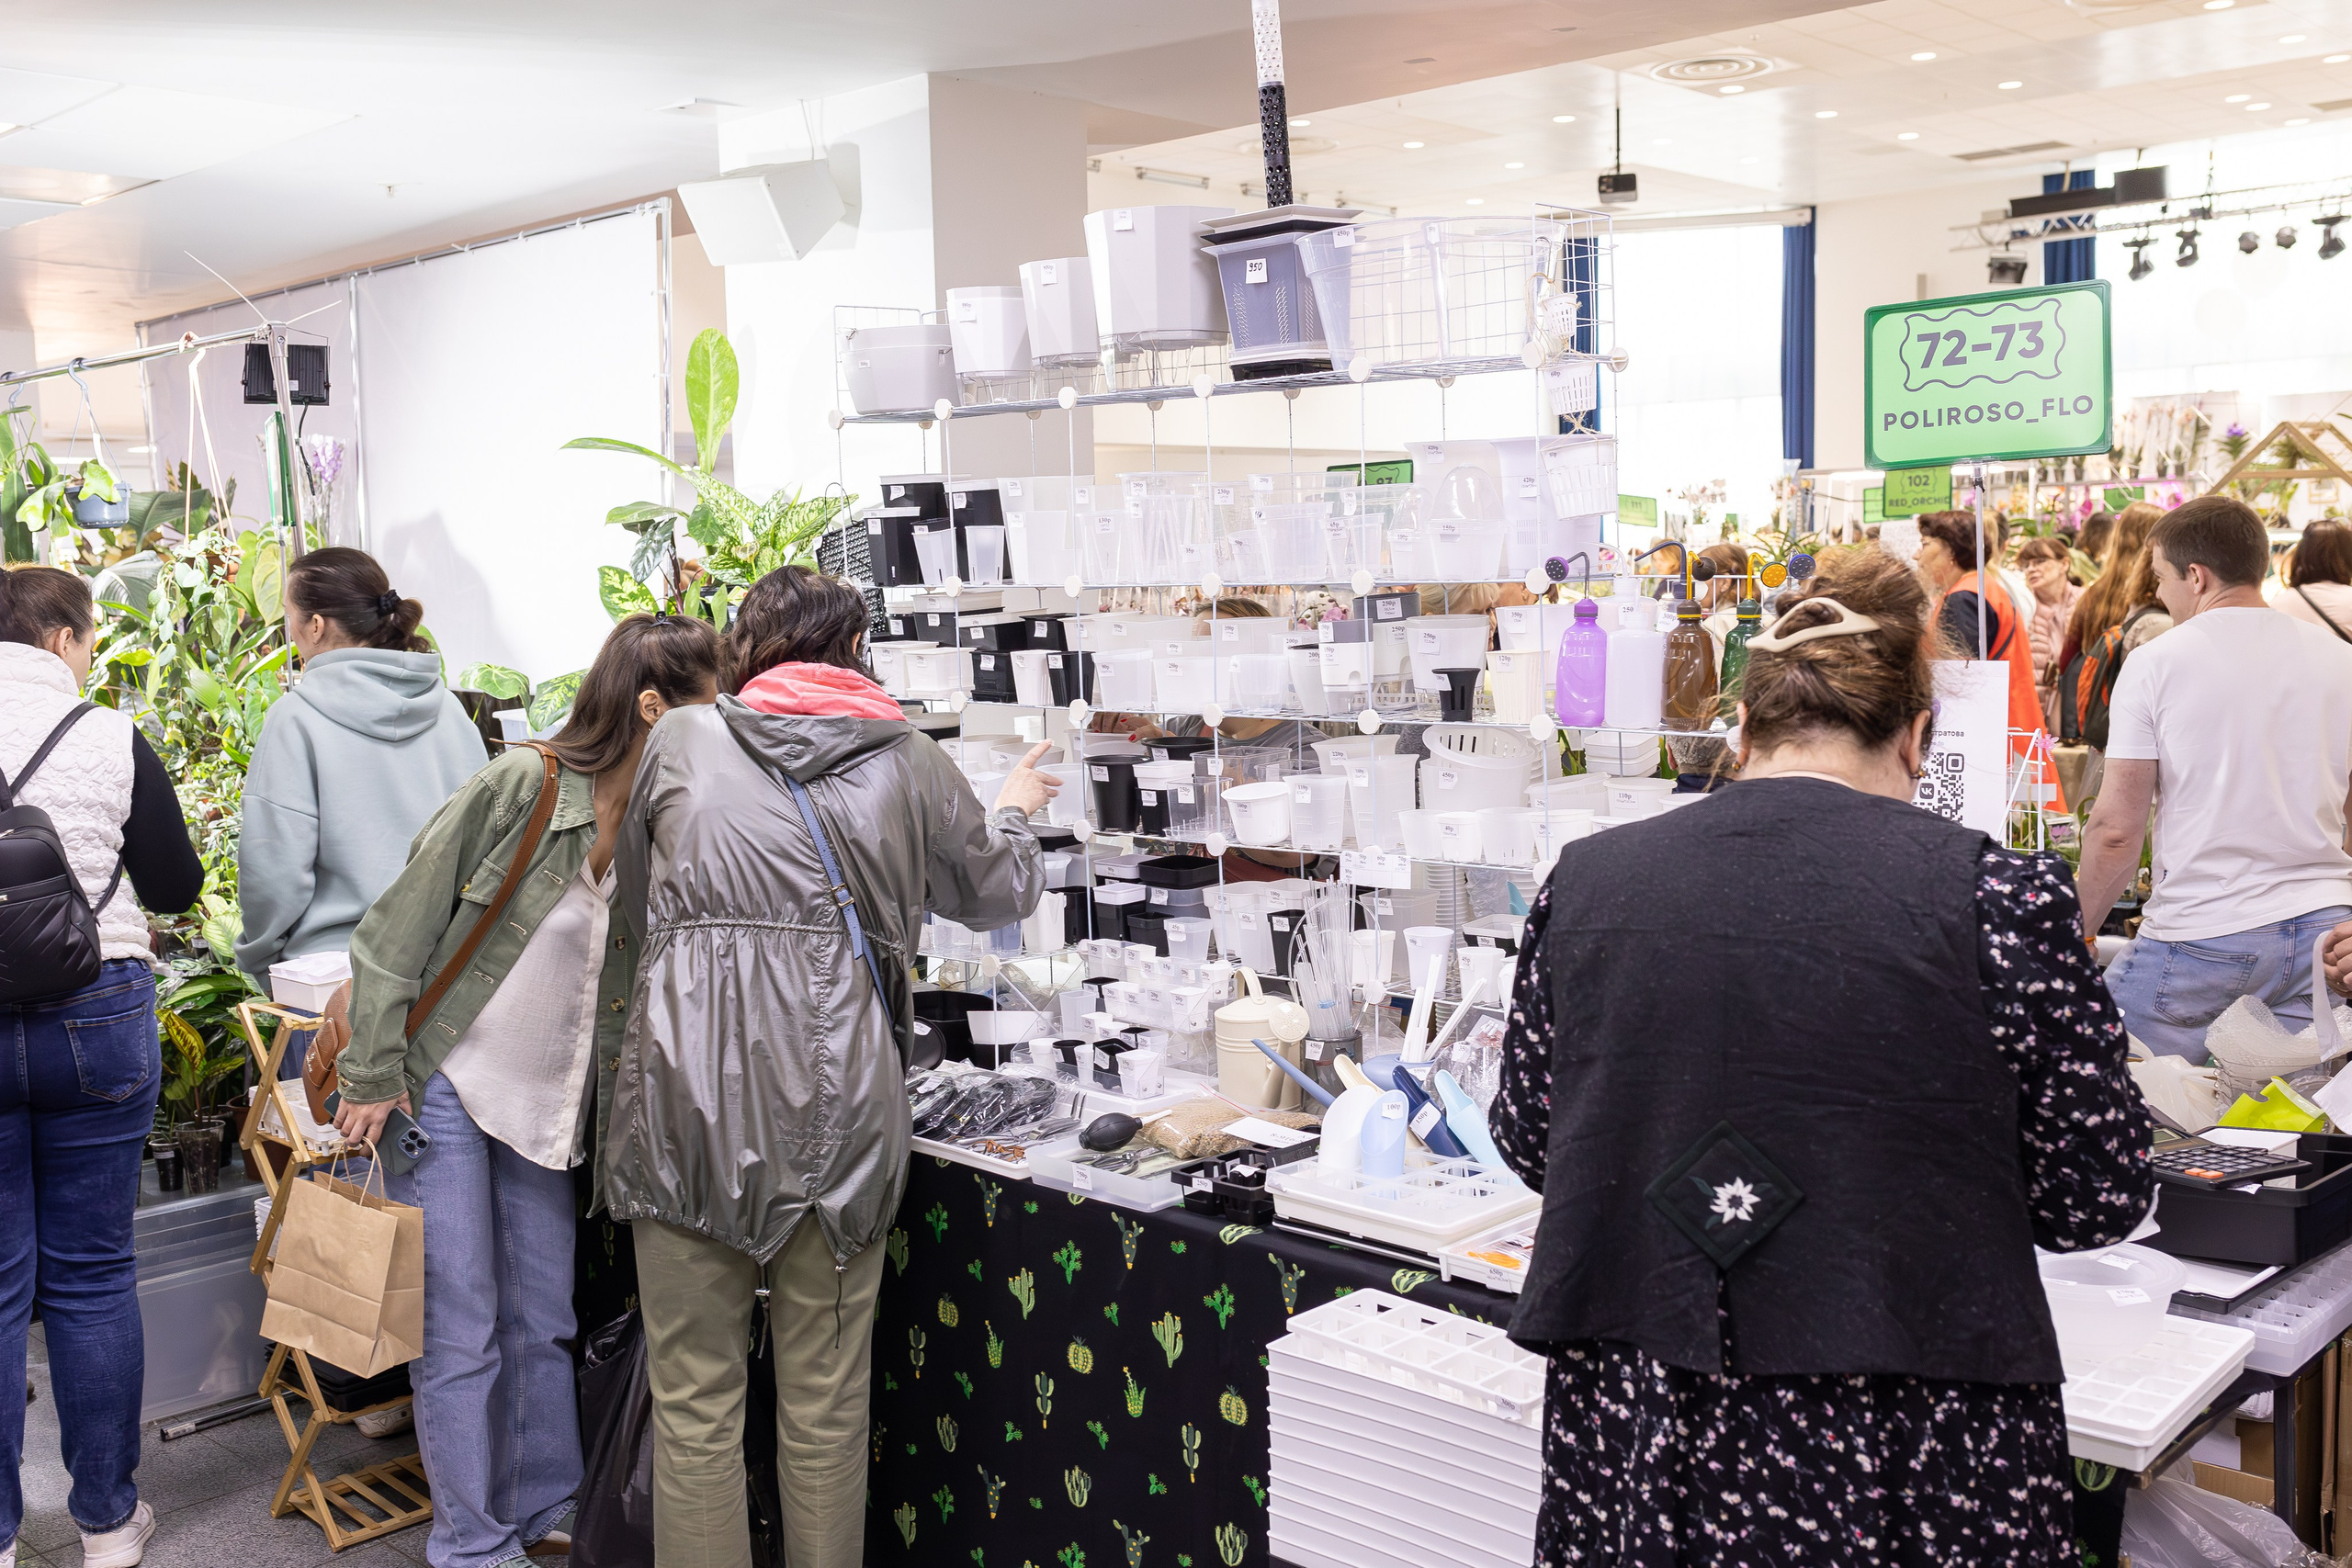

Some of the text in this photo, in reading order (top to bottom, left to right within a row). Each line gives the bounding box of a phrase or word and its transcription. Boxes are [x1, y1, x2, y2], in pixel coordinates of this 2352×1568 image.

[1249, 262, 1263, 272] 950
[1917, 321, 2045, 369] 72-73
[1883, 395, 2094, 431] POLIROSO_FLO
[1907, 475, 1930, 487] 102
[1662, 613, 1677, 622] 300р
[1423, 632, 1436, 640] 250р
[1331, 750, 1344, 758] 220р
[1441, 771, 1454, 779] 450р
[1619, 792, 1632, 800] 110р
[1444, 825, 1454, 833] 40р
[1386, 1103, 1401, 1111] 100р
[1415, 1110, 1429, 1125] 150р
